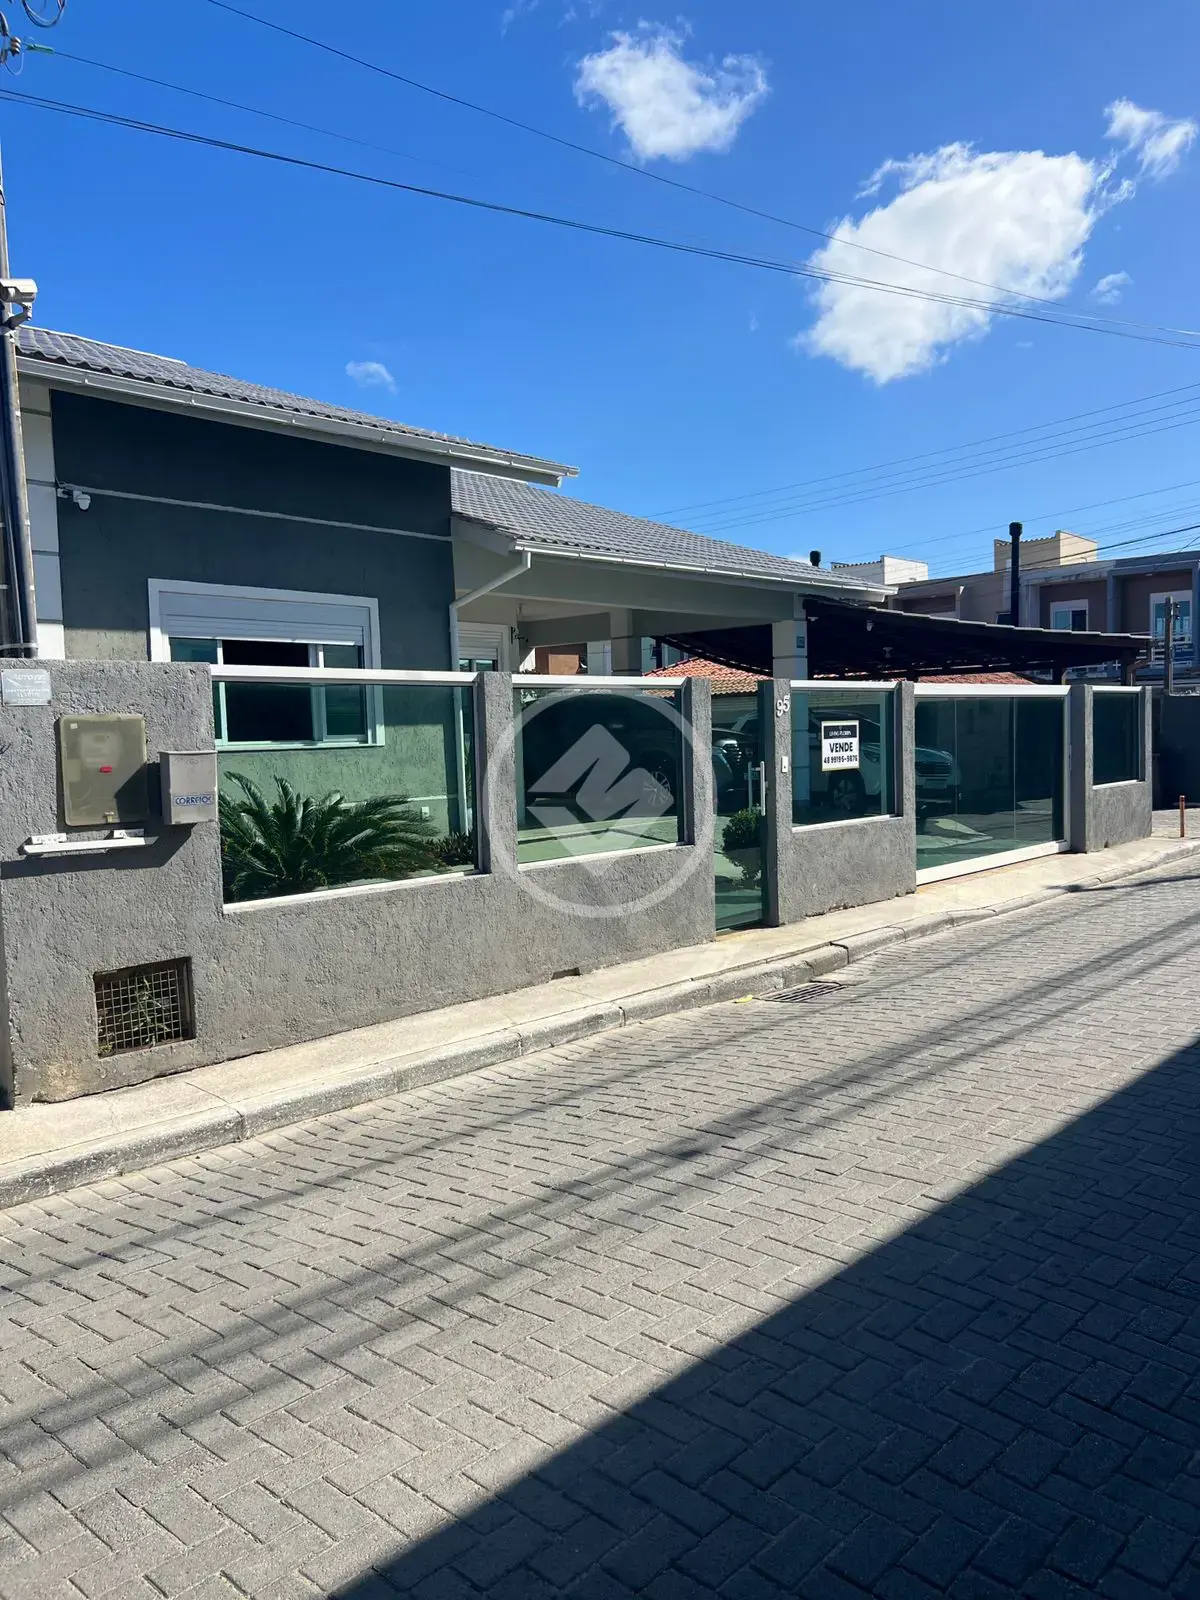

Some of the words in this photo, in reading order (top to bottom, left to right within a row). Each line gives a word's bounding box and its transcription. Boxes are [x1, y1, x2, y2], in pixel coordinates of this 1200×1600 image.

[776, 695, 790, 717] 95
[829, 742, 853, 753] VENDE
[823, 756, 831, 764] 48
